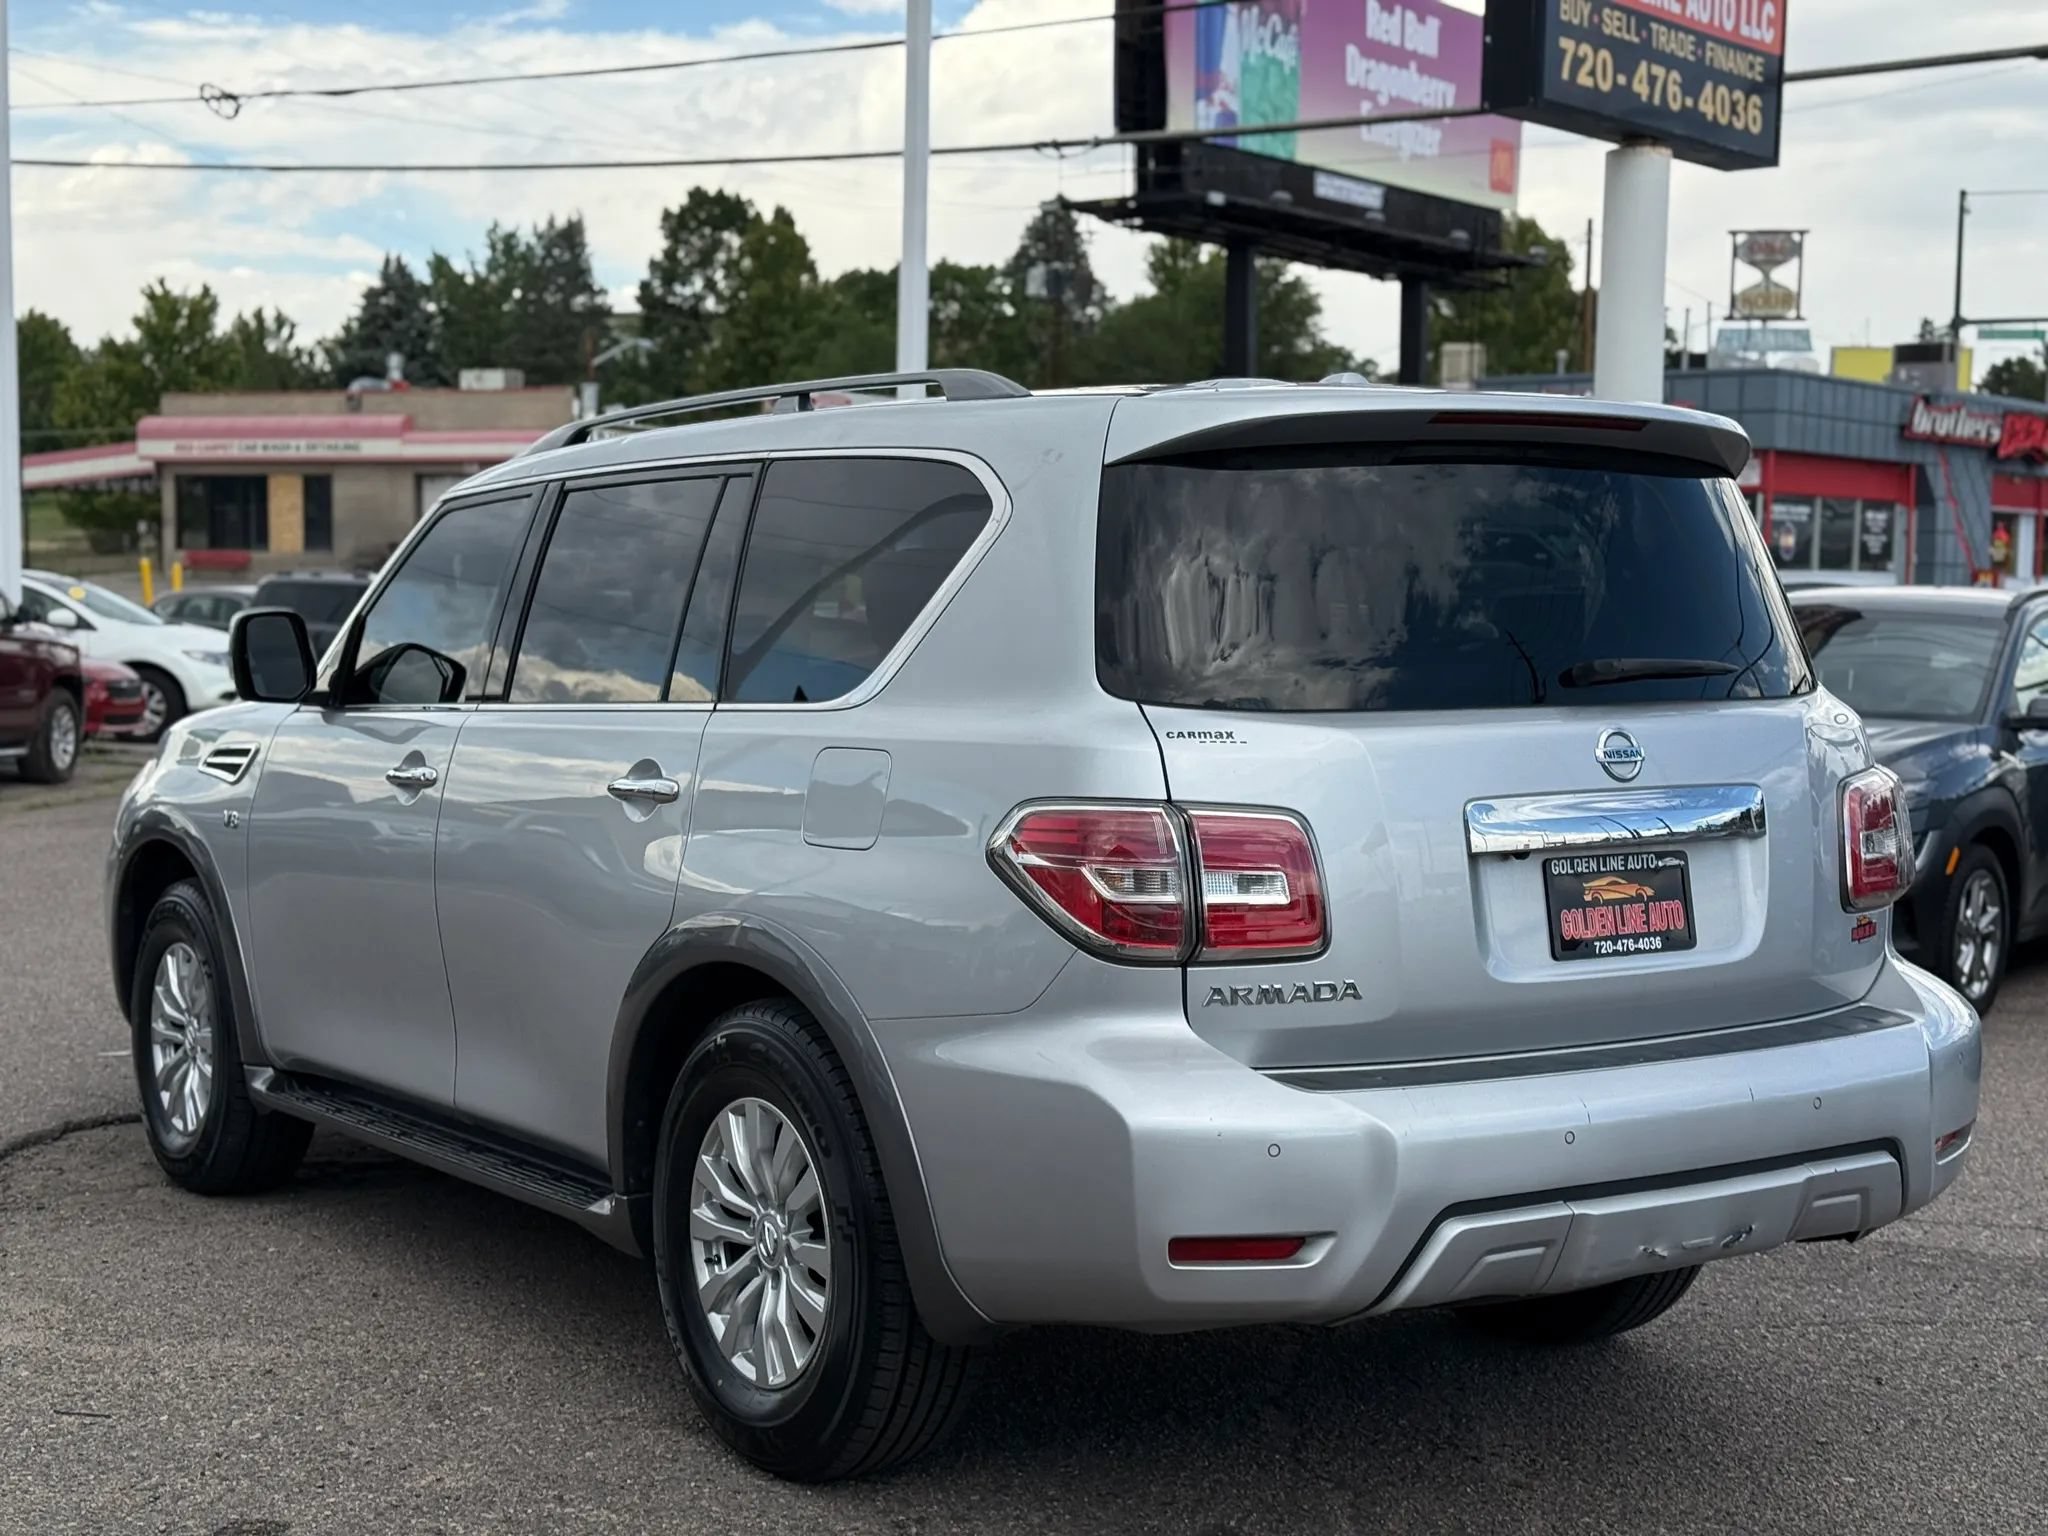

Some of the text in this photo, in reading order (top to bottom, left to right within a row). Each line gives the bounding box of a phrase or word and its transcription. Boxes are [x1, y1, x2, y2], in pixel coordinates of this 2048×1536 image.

[1366, 0, 1440, 58] Red Bull
[1559, 0, 1766, 82] BUY SELL TRADE FINANCE
[1739, 0, 1776, 44] LLC
[1346, 43, 1456, 110] Dragonberry
[1603, 749, 1642, 759] NISSAN
[1551, 853, 1656, 875] GOLDEN LINE AUTO
[1561, 899, 1685, 941] GOLDEN LINE AUTO
[1594, 936, 1662, 954] 720-476-4036
[1202, 978, 1363, 1007] ARMADA
